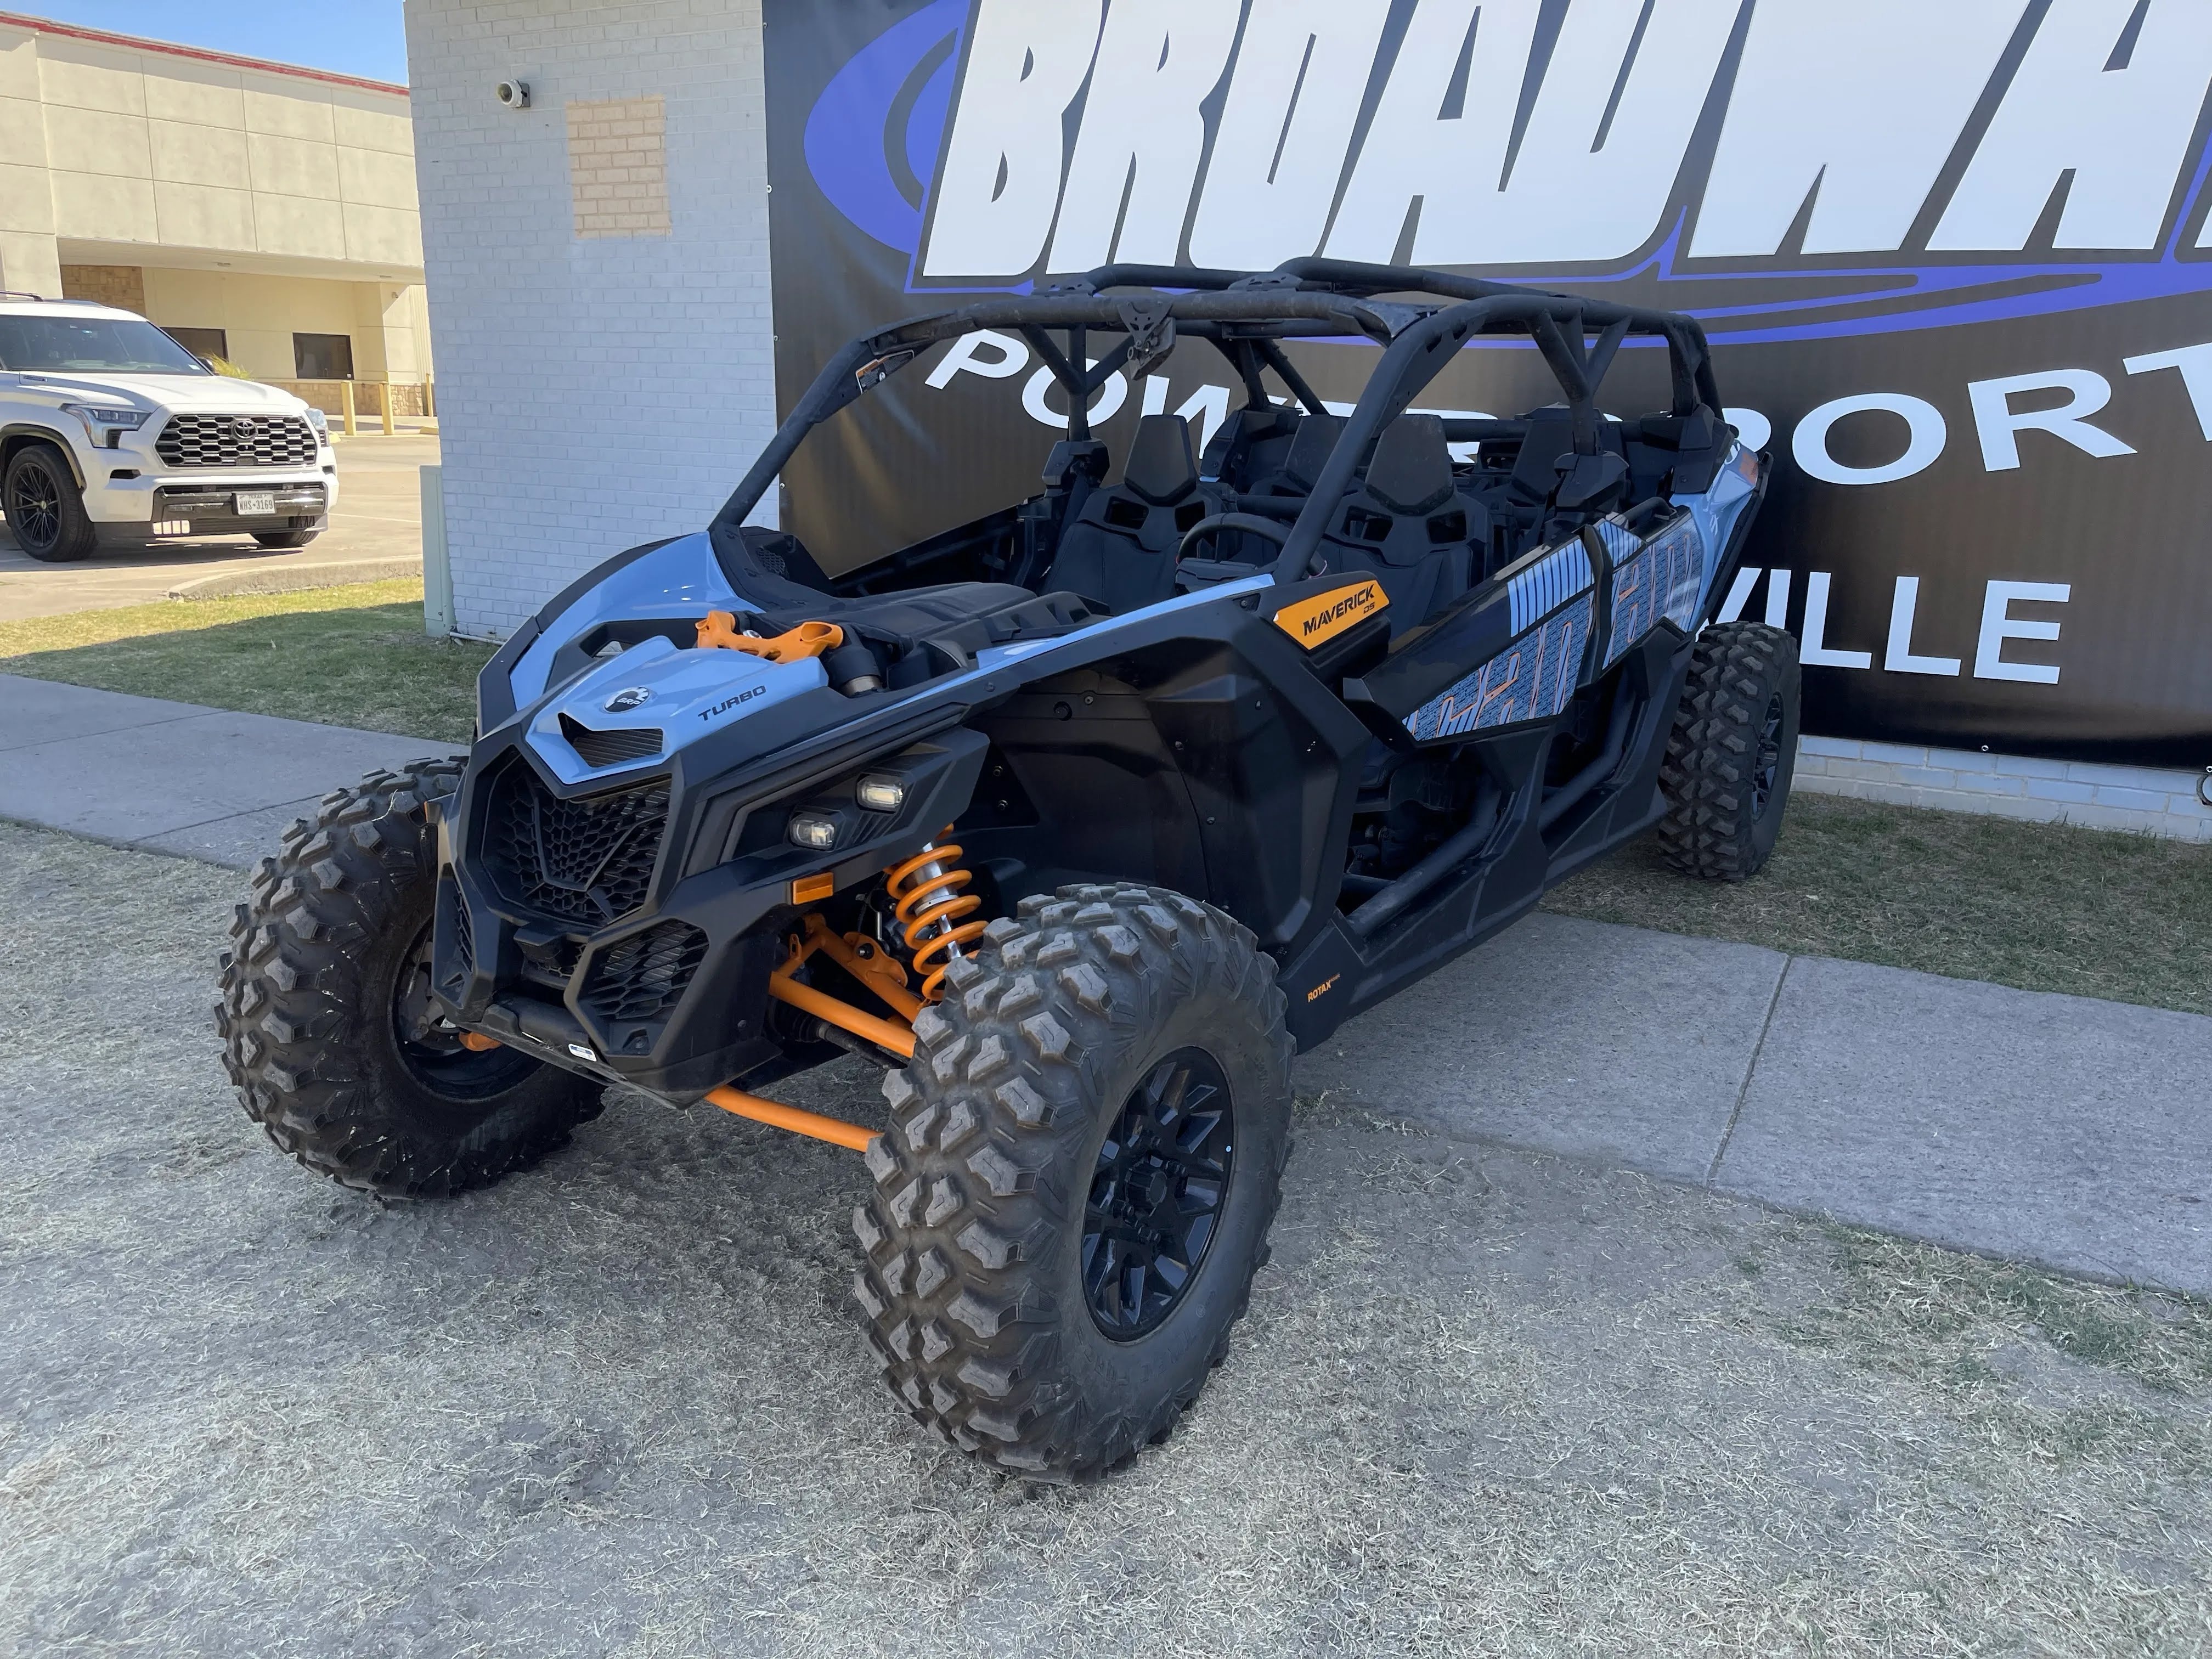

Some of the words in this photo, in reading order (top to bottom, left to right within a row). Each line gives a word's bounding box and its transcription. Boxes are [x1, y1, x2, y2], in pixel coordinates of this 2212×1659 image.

[923, 0, 2212, 276] BROADWA
[1303, 584, 1375, 636] MAVERICK
[1363, 602, 1375, 614] DS
[617, 697, 641, 706] BRP
[698, 685, 766, 721] TURBO
[1308, 979, 1331, 1003] ROTAX
